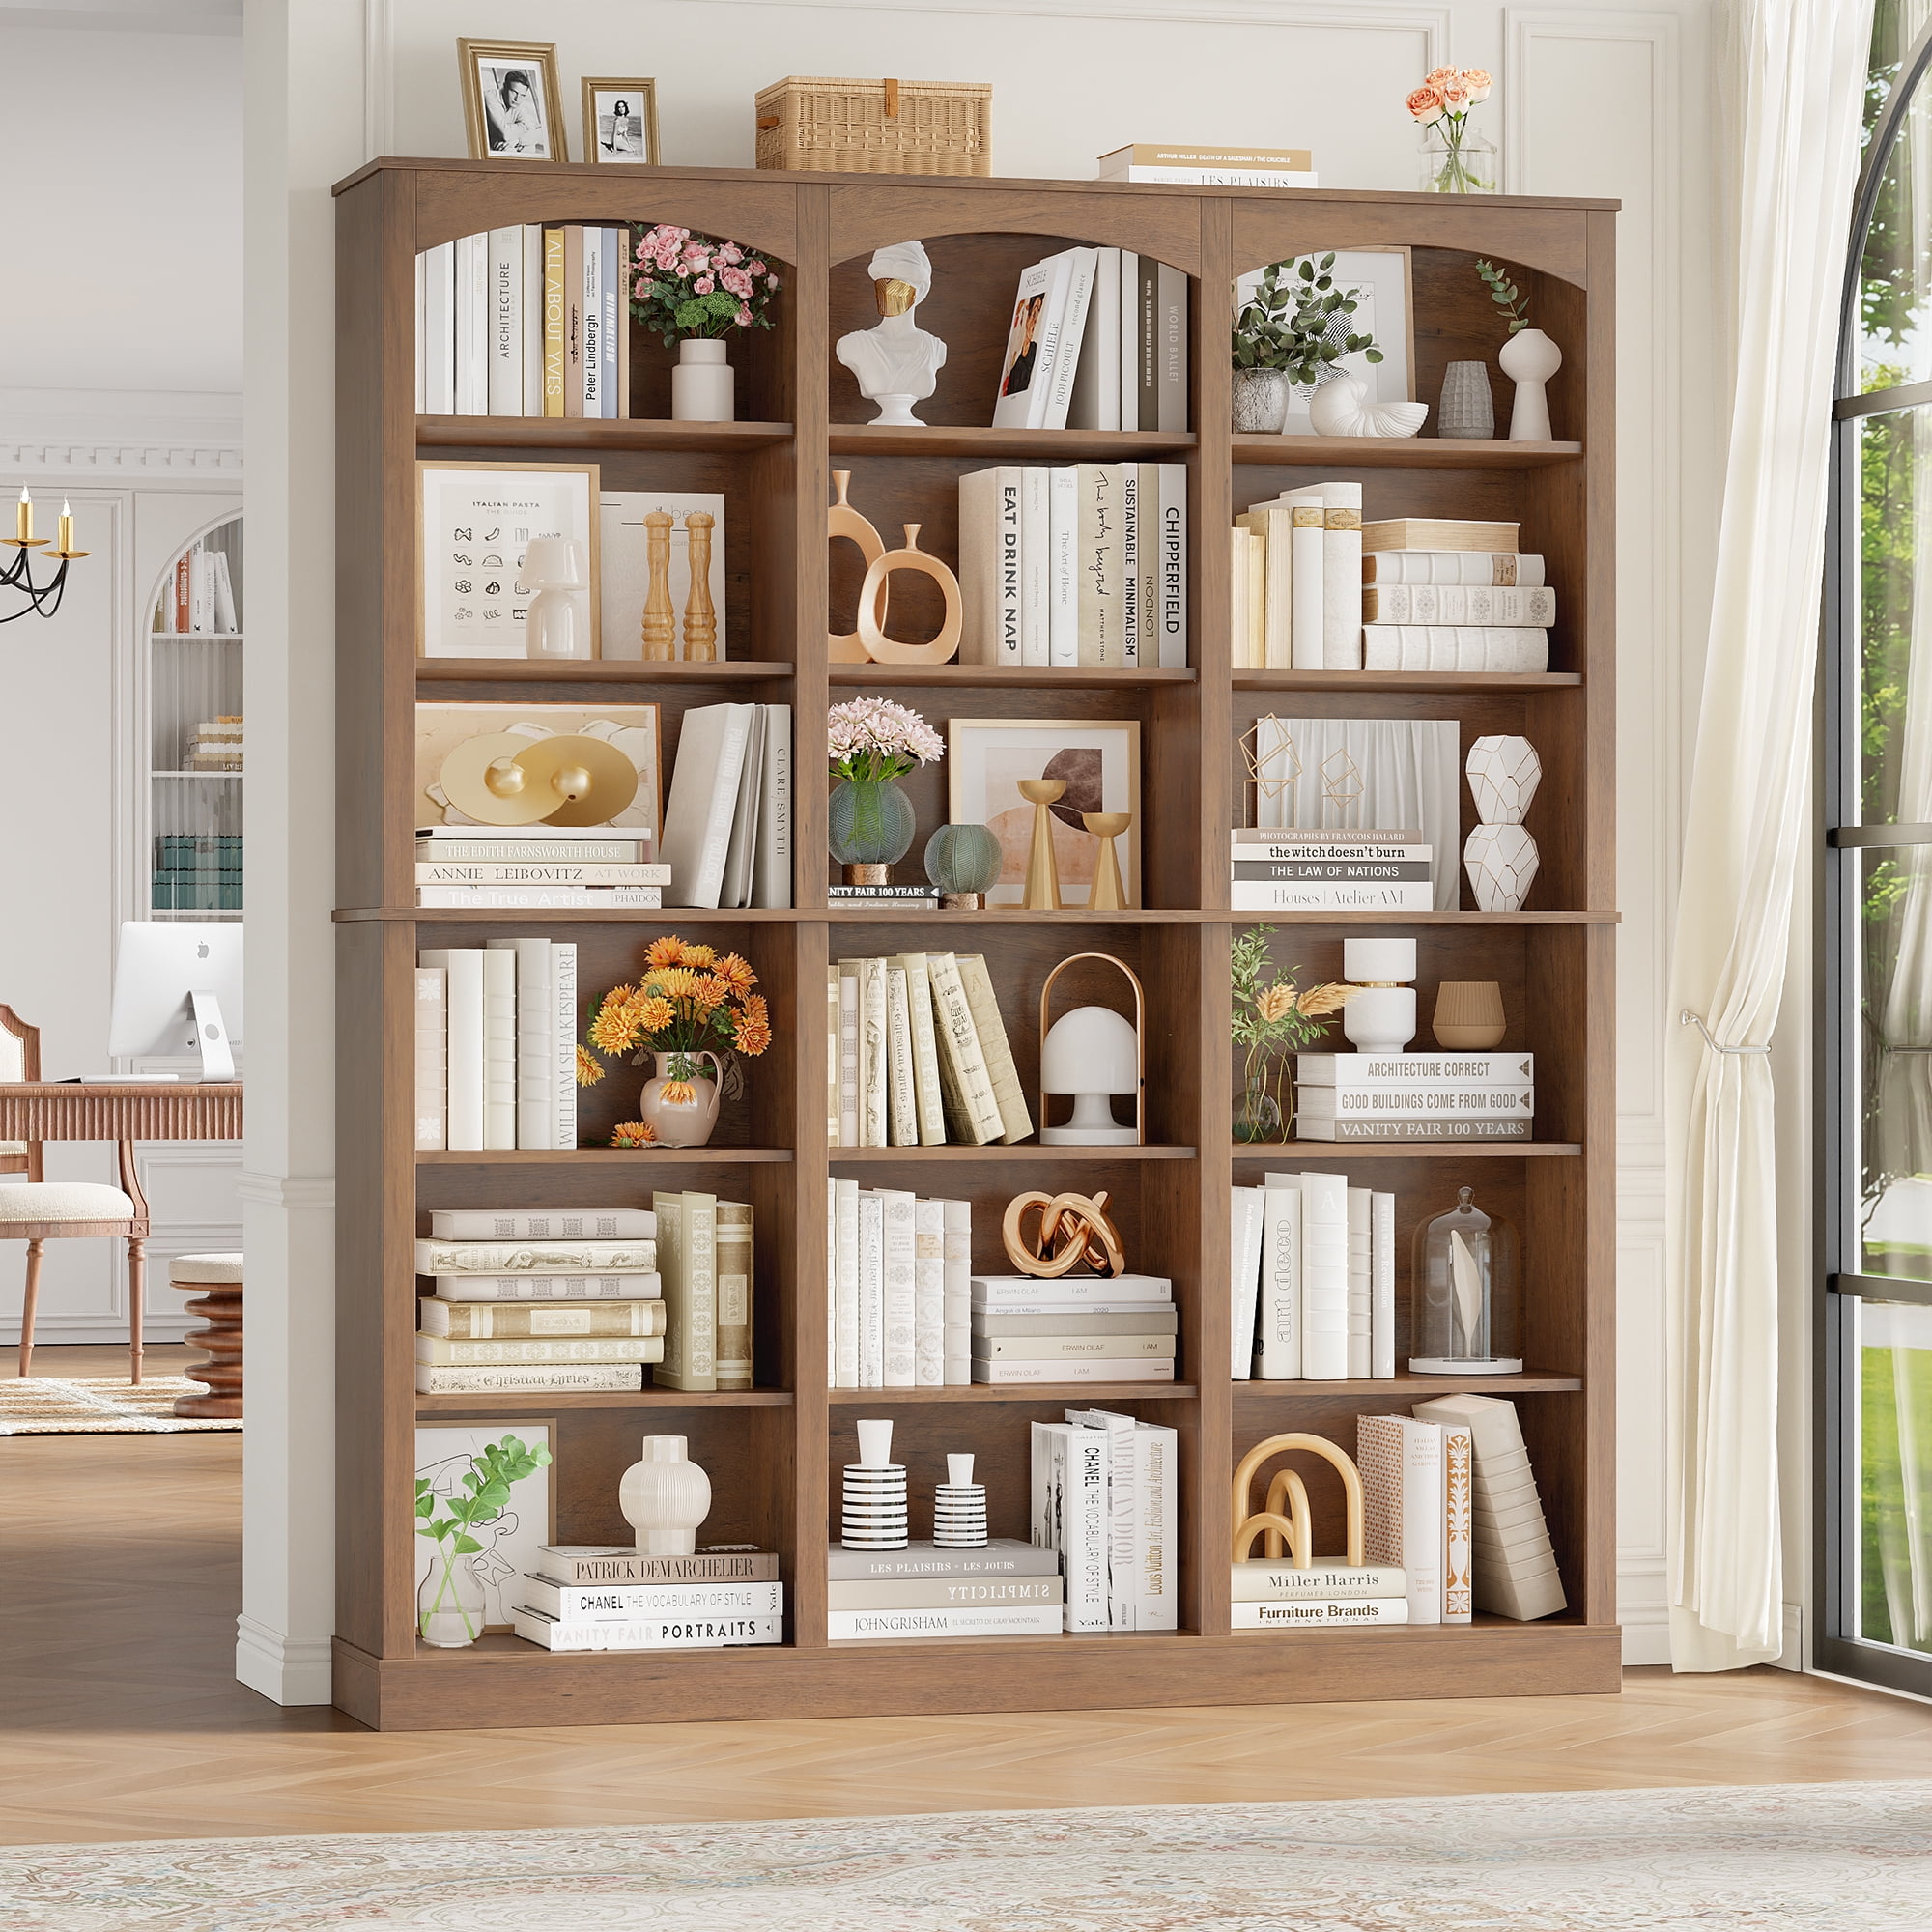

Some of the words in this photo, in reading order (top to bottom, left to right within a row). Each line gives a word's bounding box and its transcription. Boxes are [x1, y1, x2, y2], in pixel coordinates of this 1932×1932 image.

[1202, 175, 1223, 186] LES
[1231, 176, 1289, 187] PLAISIRS
[546, 240, 562, 272] ALL
[500, 262, 510, 358] ARCHITECTURE
[546, 280, 562, 342] ABOUT
[1072, 299, 1082, 325] second
[1169, 305, 1179, 343] WORLD
[605, 292, 614, 363] MINIMALISM
[585, 315, 598, 369] Lindbergh
[1041, 322, 1059, 374] SCHIELE
[546, 348, 562, 396] YVES
[1059, 341, 1074, 381] PICOULT
[1169, 346, 1179, 383] BALLET
[585, 373, 596, 400] Peter
[1055, 381, 1066, 406] JODI
[1094, 471, 1109, 502] The
[1004, 486, 1017, 525] EAT
[1094, 507, 1113, 539] body
[1125, 479, 1136, 566] SUSTAINABLE
[1061, 531, 1070, 549] The
[1004, 533, 1017, 599] DRINK
[1061, 551, 1070, 565] Art
[1089, 547, 1110, 595] beyond
[1166, 507, 1179, 634] CHIPPERFIELD
[1061, 577, 1070, 605] Home
[1125, 578, 1136, 656] MINIMALISM
[1146, 576, 1154, 637] LONDON
[1005, 608, 1017, 651] NAP
[723, 727, 744, 778] PAINTING
[777, 748, 785, 796] CLARE
[777, 803, 785, 856] SMYTH
[1332, 833, 1371, 842] FRANÇOIS
[446, 845, 469, 858] THE
[470, 845, 504, 858] EDITH
[507, 845, 581, 858] FARNSWORTH
[584, 846, 621, 858] HOUSE
[1270, 846, 1290, 858] the
[1292, 846, 1327, 858] witch
[1376, 847, 1405, 858] burn
[429, 867, 483, 879] ANNIE
[495, 867, 582, 880] LEIBOVITZ
[595, 869, 612, 879] AT
[618, 869, 660, 879] WORK
[1270, 867, 1293, 877] THE
[1298, 867, 1322, 877] LAW
[1327, 867, 1342, 877] OF
[1347, 867, 1399, 877] NATIONS
[449, 892, 483, 905] The
[487, 892, 531, 905] True
[537, 892, 594, 905] Artist
[614, 894, 660, 903] PHAIDON
[855, 887, 877, 896] FAIR
[879, 888, 893, 896] 100
[895, 888, 924, 896] YEARS
[1274, 890, 1320, 904] Houses
[1332, 890, 1376, 904] Atelier
[1378, 890, 1403, 904] AM
[560, 951, 574, 1064] SHAKESPEARE
[1368, 1062, 1442, 1077] ARCHITECTURE
[1444, 1062, 1490, 1076] CORRECT
[560, 1071, 574, 1145] WILLIAM
[1342, 1094, 1368, 1109] GOOD
[1373, 1094, 1423, 1109] BUILDINGS
[1427, 1094, 1455, 1109] COME
[1459, 1094, 1486, 1109] FROM
[1490, 1094, 1516, 1109] GOOD
[1342, 1123, 1403, 1136] VANITY
[1406, 1123, 1442, 1135] FAIR
[1447, 1123, 1470, 1135] 100
[1475, 1123, 1524, 1135] YEARS
[1275, 1220, 1291, 1291] deco
[1277, 1299, 1291, 1343] art
[1085, 1448, 1099, 1487] CHANEL
[1115, 1429, 1134, 1517] AMERICAN
[1144, 1442, 1163, 1484] Architecture
[1086, 1490, 1099, 1505] THE
[1145, 1486, 1162, 1501] and
[1144, 1501, 1162, 1527] Fashion
[1086, 1507, 1099, 1565] VOCABULARY
[1115, 1522, 1134, 1566] DIOR
[576, 1559, 636, 1579] PATRICK
[641, 1557, 753, 1578] DEMARCHELIER
[870, 1563, 892, 1573] LES
[896, 1562, 952, 1573] PLAISIRS
[964, 1562, 981, 1571] LES
[984, 1561, 1015, 1570] JOURS
[1086, 1565, 1099, 1577] OF
[1144, 1545, 1162, 1573] Vuitton
[1086, 1577, 1099, 1604] STYLE
[1145, 1575, 1162, 1595] Louis
[1267, 1574, 1320, 1587] Miller
[1325, 1573, 1379, 1586] Harris
[580, 1596, 623, 1609] CHANEL
[627, 1595, 643, 1608] THE
[646, 1594, 707, 1607] VOCABULARY
[710, 1594, 722, 1605] OF
[724, 1592, 752, 1605] STYLE
[1259, 1605, 1323, 1619] Furniture
[1328, 1604, 1378, 1617] Brands
[554, 1628, 609, 1643] VANITY
[618, 1627, 653, 1640] FAIR
[662, 1621, 756, 1638] PORTRAITS
